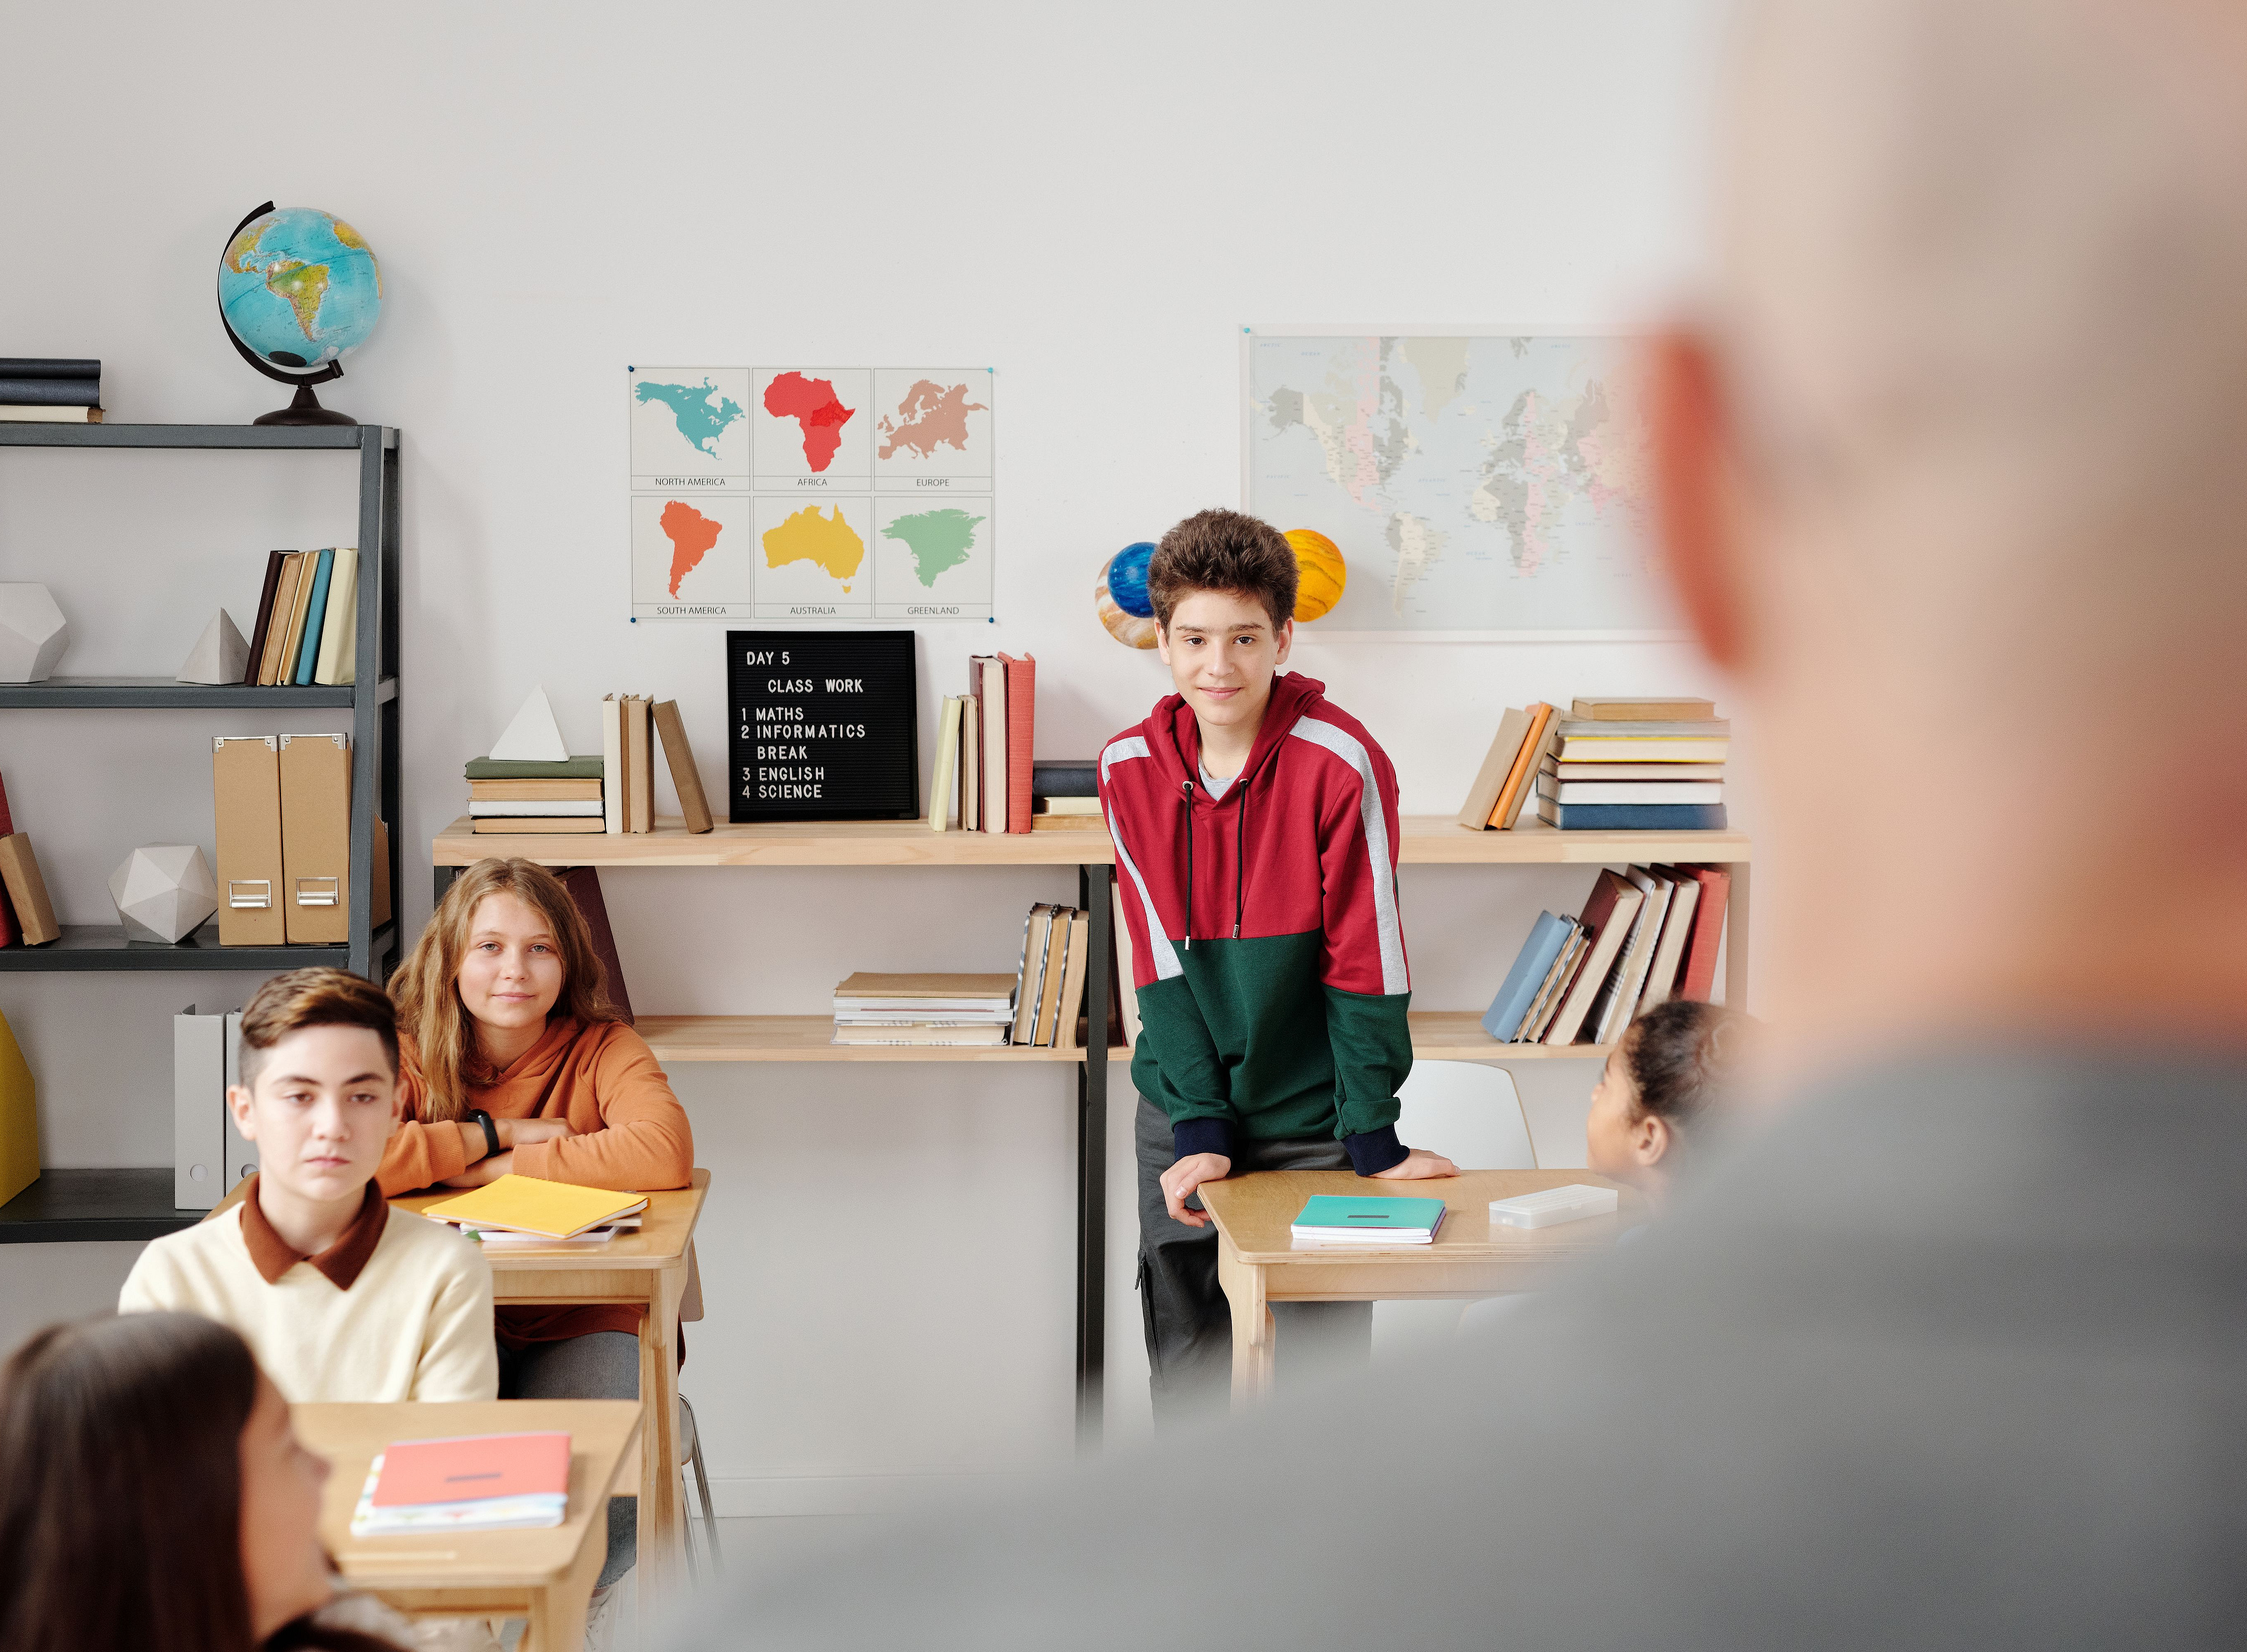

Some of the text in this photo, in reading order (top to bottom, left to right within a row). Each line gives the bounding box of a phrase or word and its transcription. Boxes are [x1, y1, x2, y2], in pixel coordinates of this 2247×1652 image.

[747, 652, 789, 665] DAY 5
[768, 679, 863, 693] CLASS WORK
[742, 707, 803, 721] 1 MATHS
[741, 725, 865, 738] 2 INFORMATICS
[758, 746, 807, 759] BREAK
[743, 767, 824, 781] 3 ENGLISH
[742, 785, 822, 798] 4 SCIENCE
